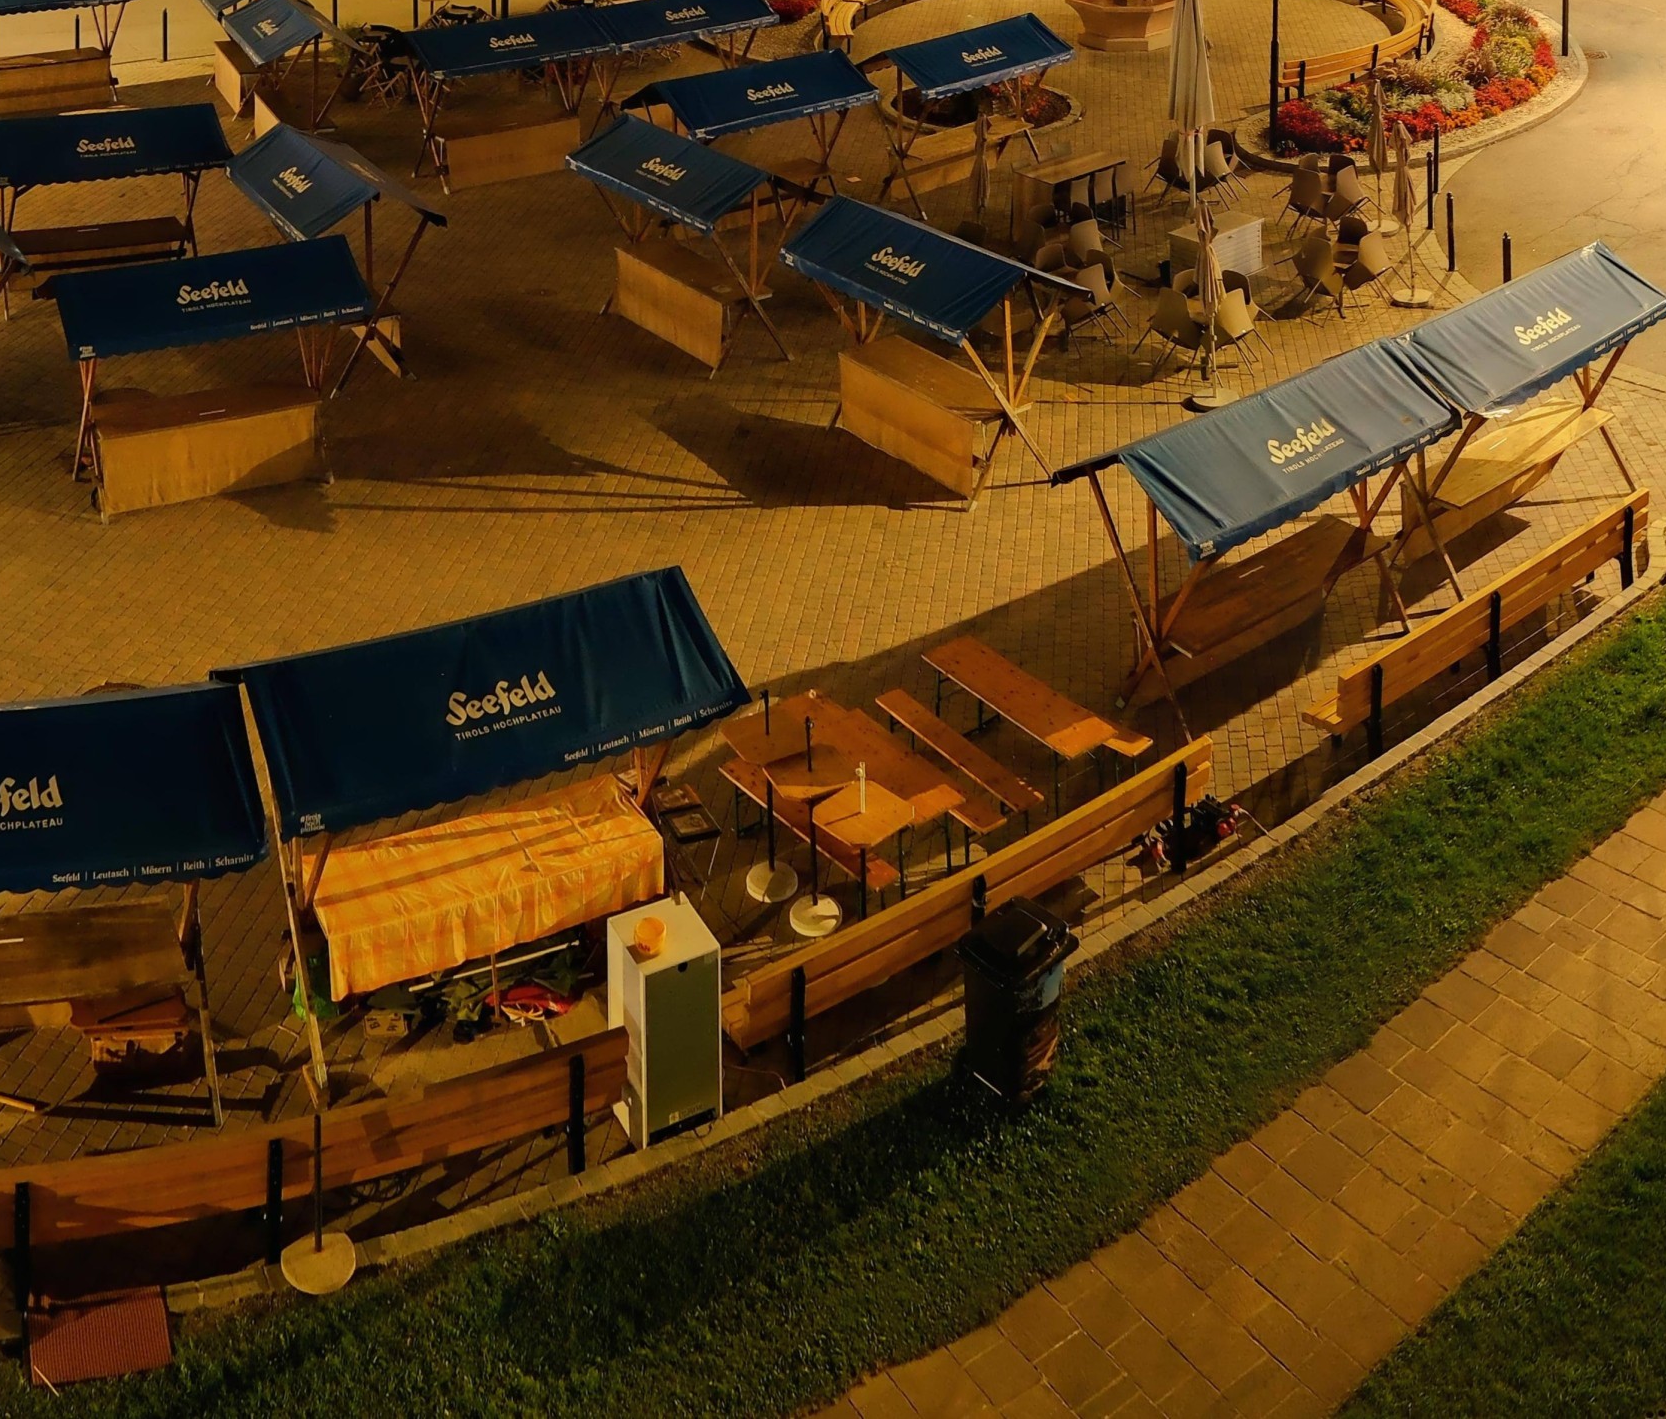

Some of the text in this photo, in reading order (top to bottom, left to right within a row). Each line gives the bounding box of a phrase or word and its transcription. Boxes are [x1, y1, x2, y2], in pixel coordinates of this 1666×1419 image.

[665, 5, 707, 21] Seefeld
[489, 33, 535, 49] Seefeld
[961, 46, 1003, 63] Seefeld
[747, 82, 795, 101] Seefeld
[76, 135, 135, 154] Seefeld
[642, 157, 687, 181] Seefeld
[871, 247, 926, 279] Seefeld
[177, 278, 250, 305] Seefeld
[1514, 307, 1573, 346] Seefeld
[1267, 417, 1336, 465] Seefeld
[445, 670, 556, 727] Seefeld
[454, 704, 563, 741] TIROLS HOCHPLATEAU
